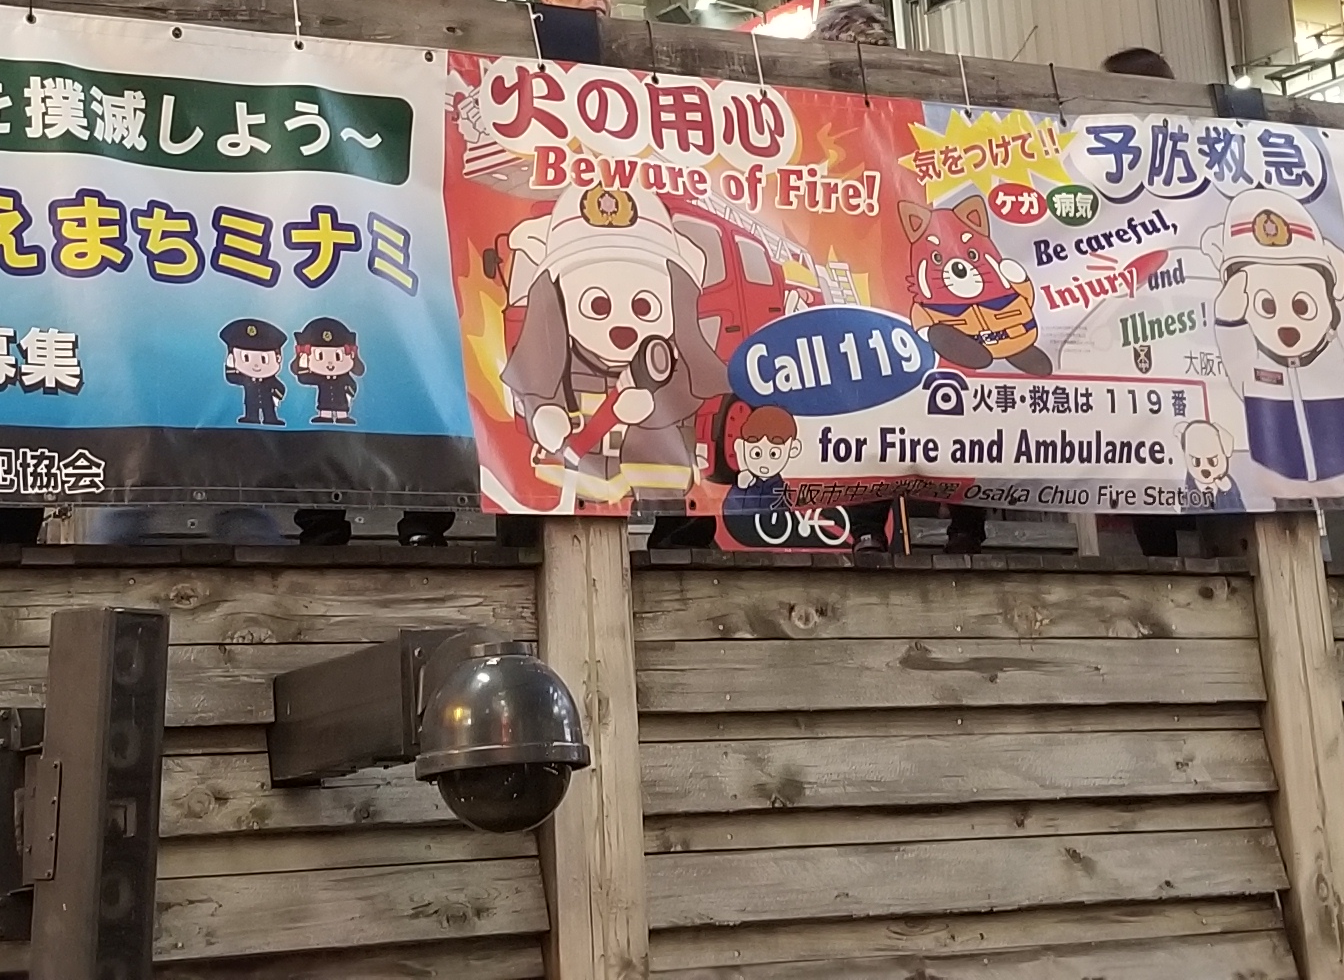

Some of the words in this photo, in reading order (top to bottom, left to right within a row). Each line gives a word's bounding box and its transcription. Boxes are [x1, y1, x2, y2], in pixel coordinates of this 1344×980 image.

[490, 65, 786, 158] 火の用心
[531, 146, 710, 198] Beware
[720, 163, 763, 211] of
[776, 166, 880, 215] Fire!
[1086, 121, 1315, 188] 予防救急
[994, 189, 1041, 217] ケガ
[1052, 191, 1095, 219] 病気
[1033, 238, 1068, 267] Be
[1074, 210, 1179, 257] careful,
[1040, 266, 1137, 311] Injury
[1147, 259, 1186, 292] and
[746, 336, 831, 396] Call
[839, 332, 922, 383] 119
[819, 427, 866, 463] for
[880, 428, 939, 464] Fire
[950, 431, 1004, 463] and
[1014, 429, 1174, 466] Ambulance.
[963, 484, 1030, 504] Osaka
[1038, 484, 1089, 506] Chuo
[1097, 485, 1137, 507] Fire
[1142, 485, 1215, 509] Station
